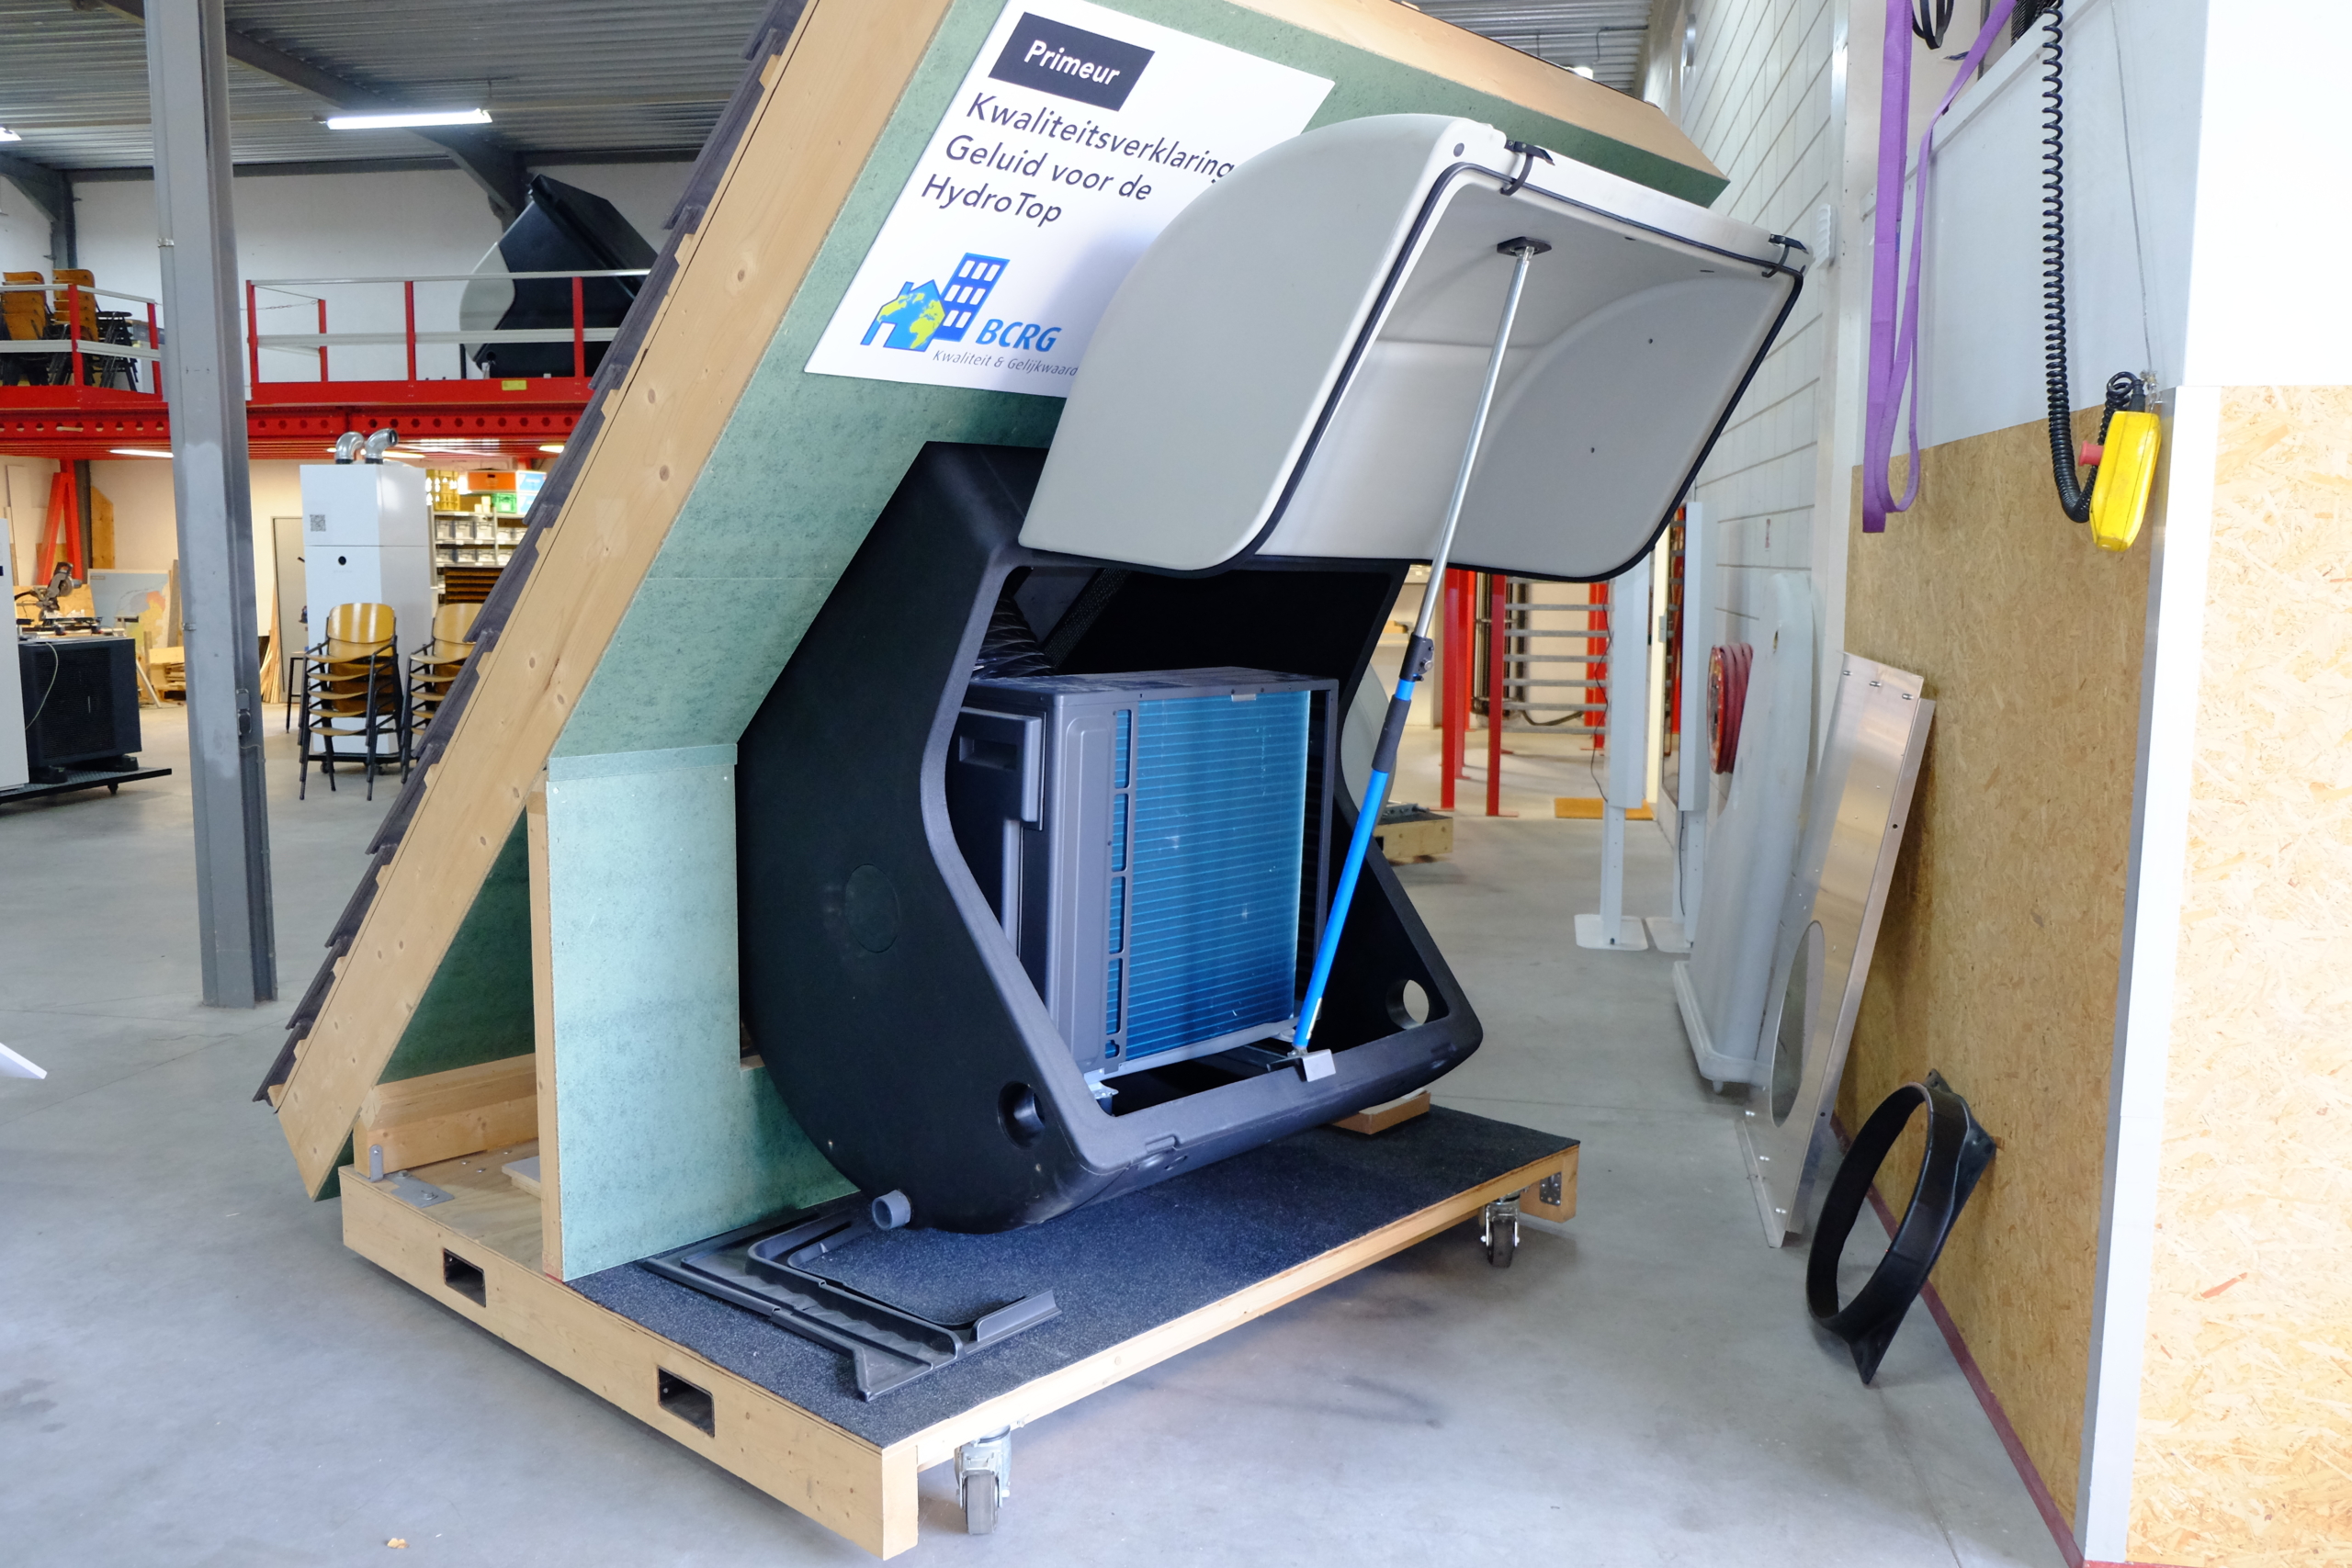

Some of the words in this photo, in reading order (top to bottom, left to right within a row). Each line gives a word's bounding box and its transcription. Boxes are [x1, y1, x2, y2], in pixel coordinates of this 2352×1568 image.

[1024, 39, 1121, 85] Primeur
[967, 92, 1235, 184] Kwaliteitsverklaring
[945, 134, 1048, 177] Geluid
[1051, 164, 1115, 193] voor
[1118, 174, 1152, 201] de
[921, 173, 1062, 228] HydroTop
[933, 350, 992, 367] Kwaliteit
[993, 356, 1004, 368] &
[975, 319, 1062, 352] BCRG
